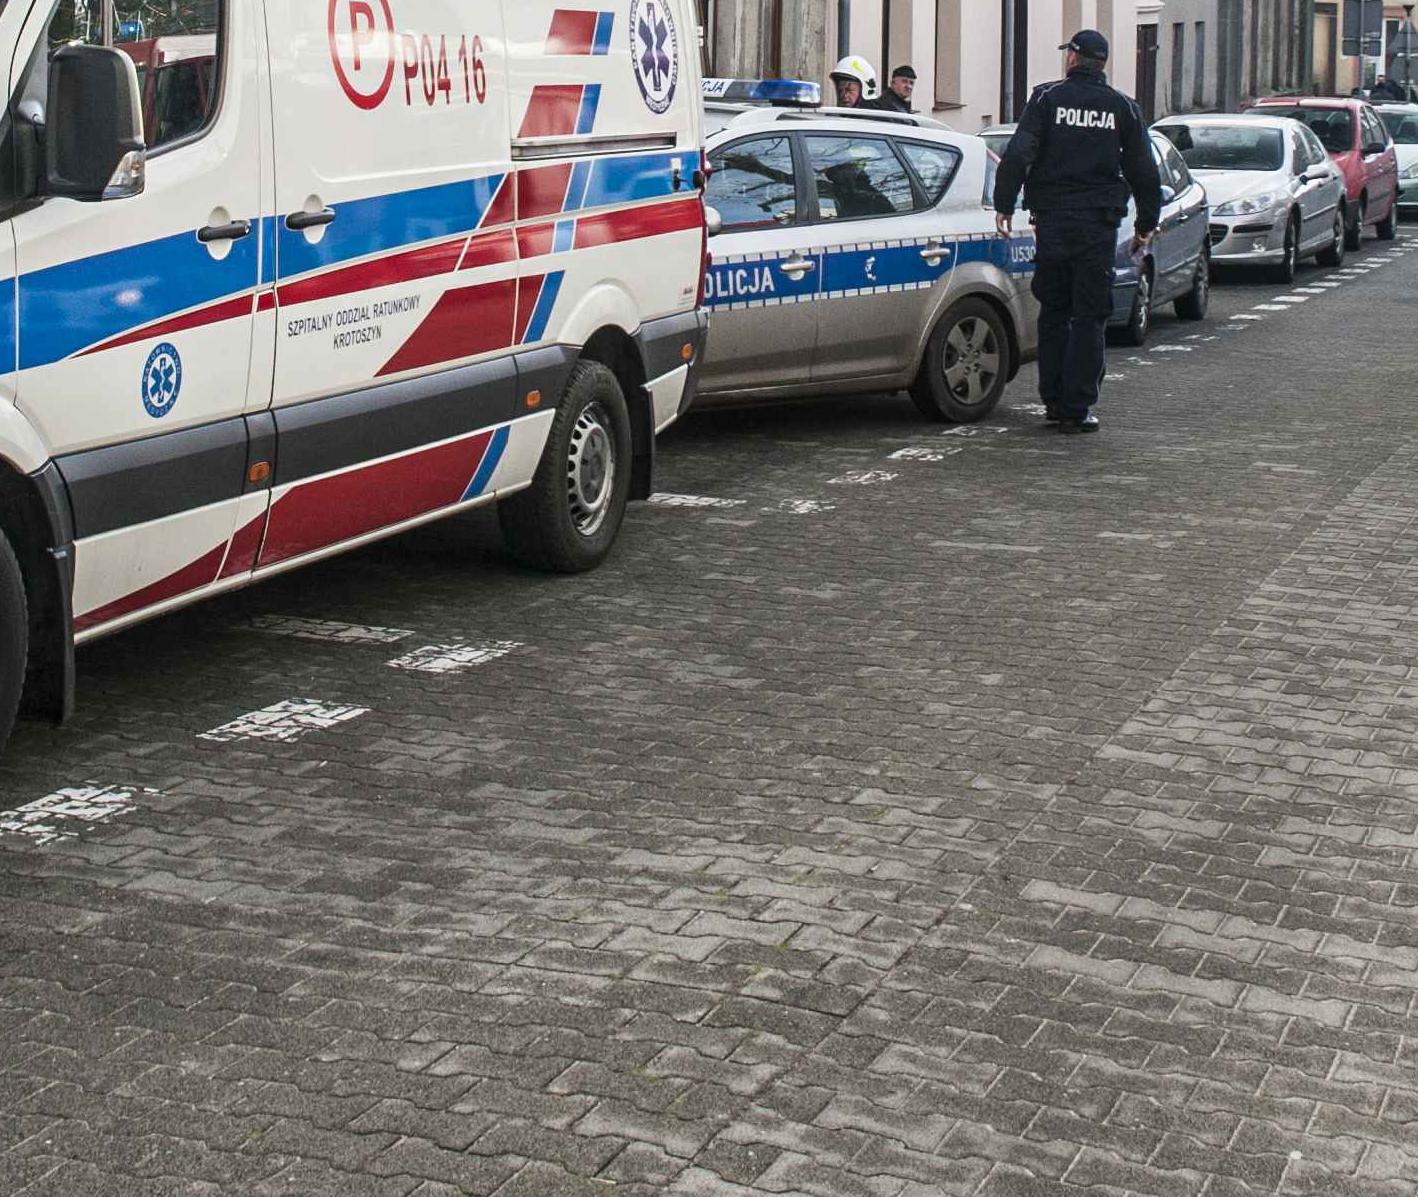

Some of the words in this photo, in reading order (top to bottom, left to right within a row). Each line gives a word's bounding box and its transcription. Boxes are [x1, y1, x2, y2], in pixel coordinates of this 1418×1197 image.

[349, 0, 375, 71] P
[401, 34, 451, 107] P04
[458, 34, 486, 105] 16
[1056, 106, 1116, 130] POLICJA
[702, 266, 775, 299] OLICJA
[287, 313, 333, 337] SZPITALNY
[373, 295, 421, 318] RATUNKOWY
[333, 325, 381, 349] KROTOSZYN
